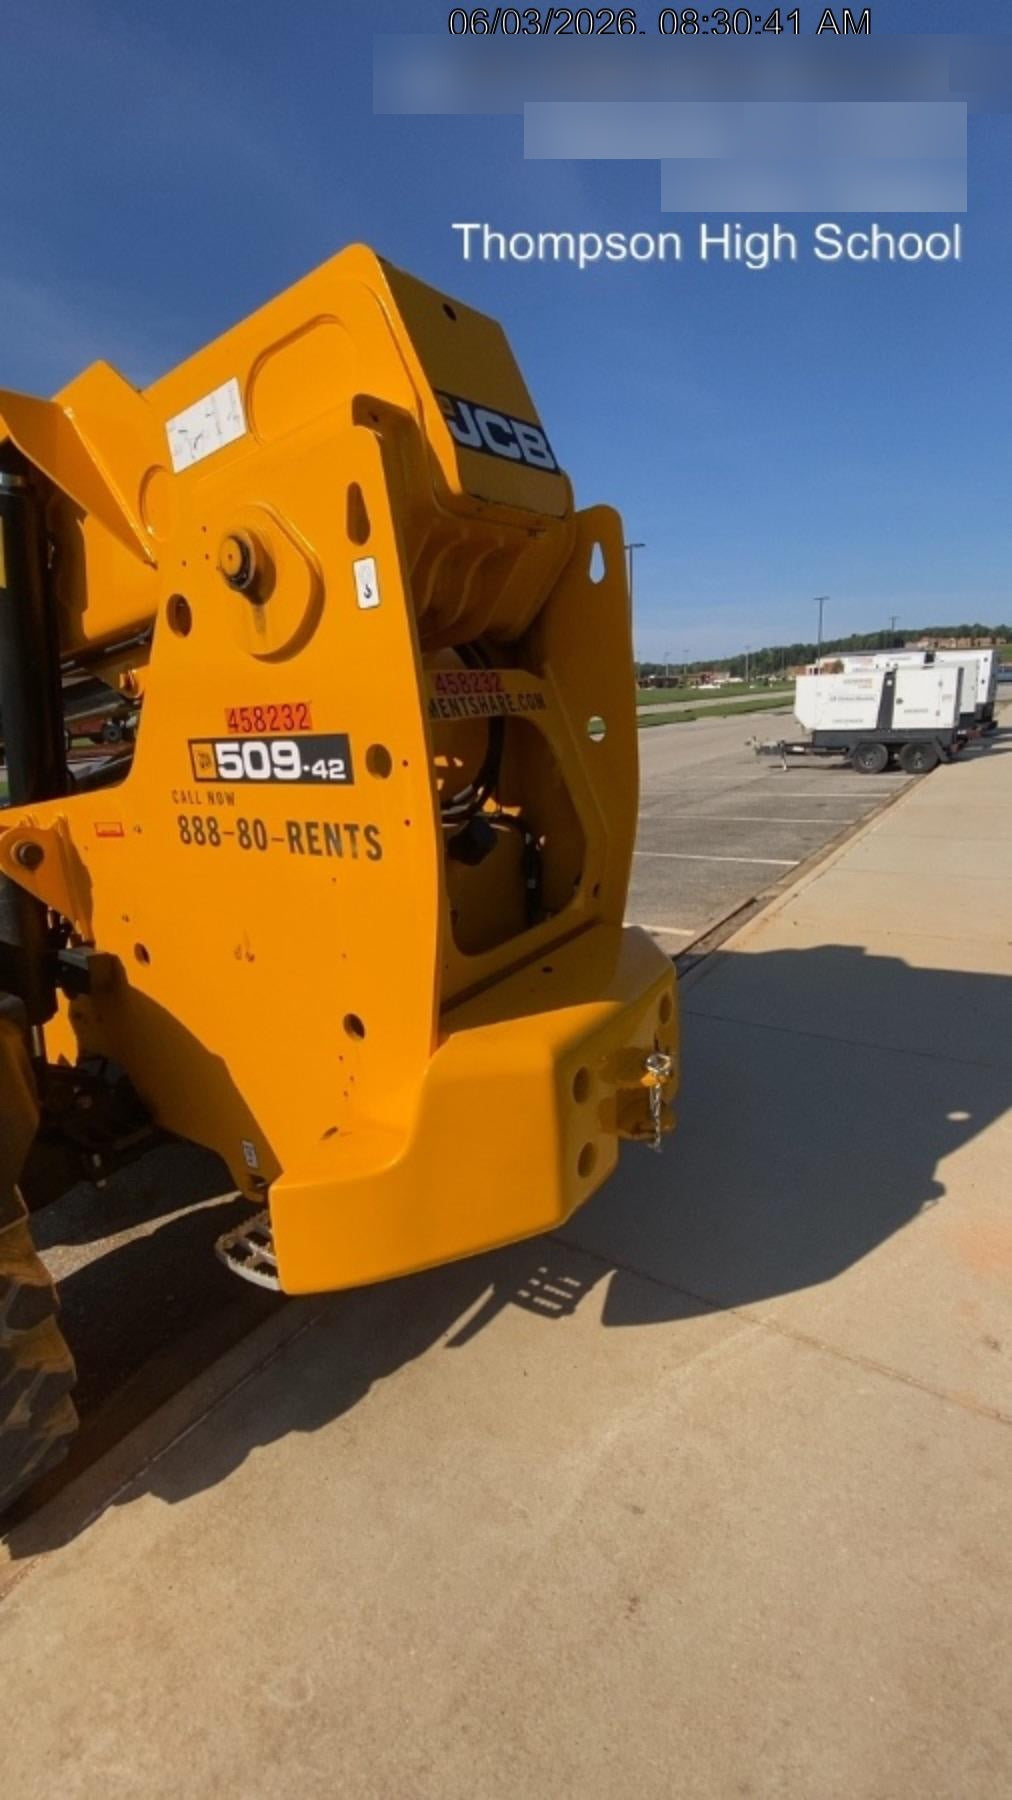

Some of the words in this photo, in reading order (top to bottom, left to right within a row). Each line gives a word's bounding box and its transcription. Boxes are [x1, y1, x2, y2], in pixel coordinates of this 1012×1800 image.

[446, 400, 557, 470] JCB
[434, 671, 504, 695] 458232
[226, 702, 311, 733] 458232
[171, 789, 202, 805] CALL
[207, 791, 236, 806] NOW
[177, 813, 384, 862] 888-80-RENTS
